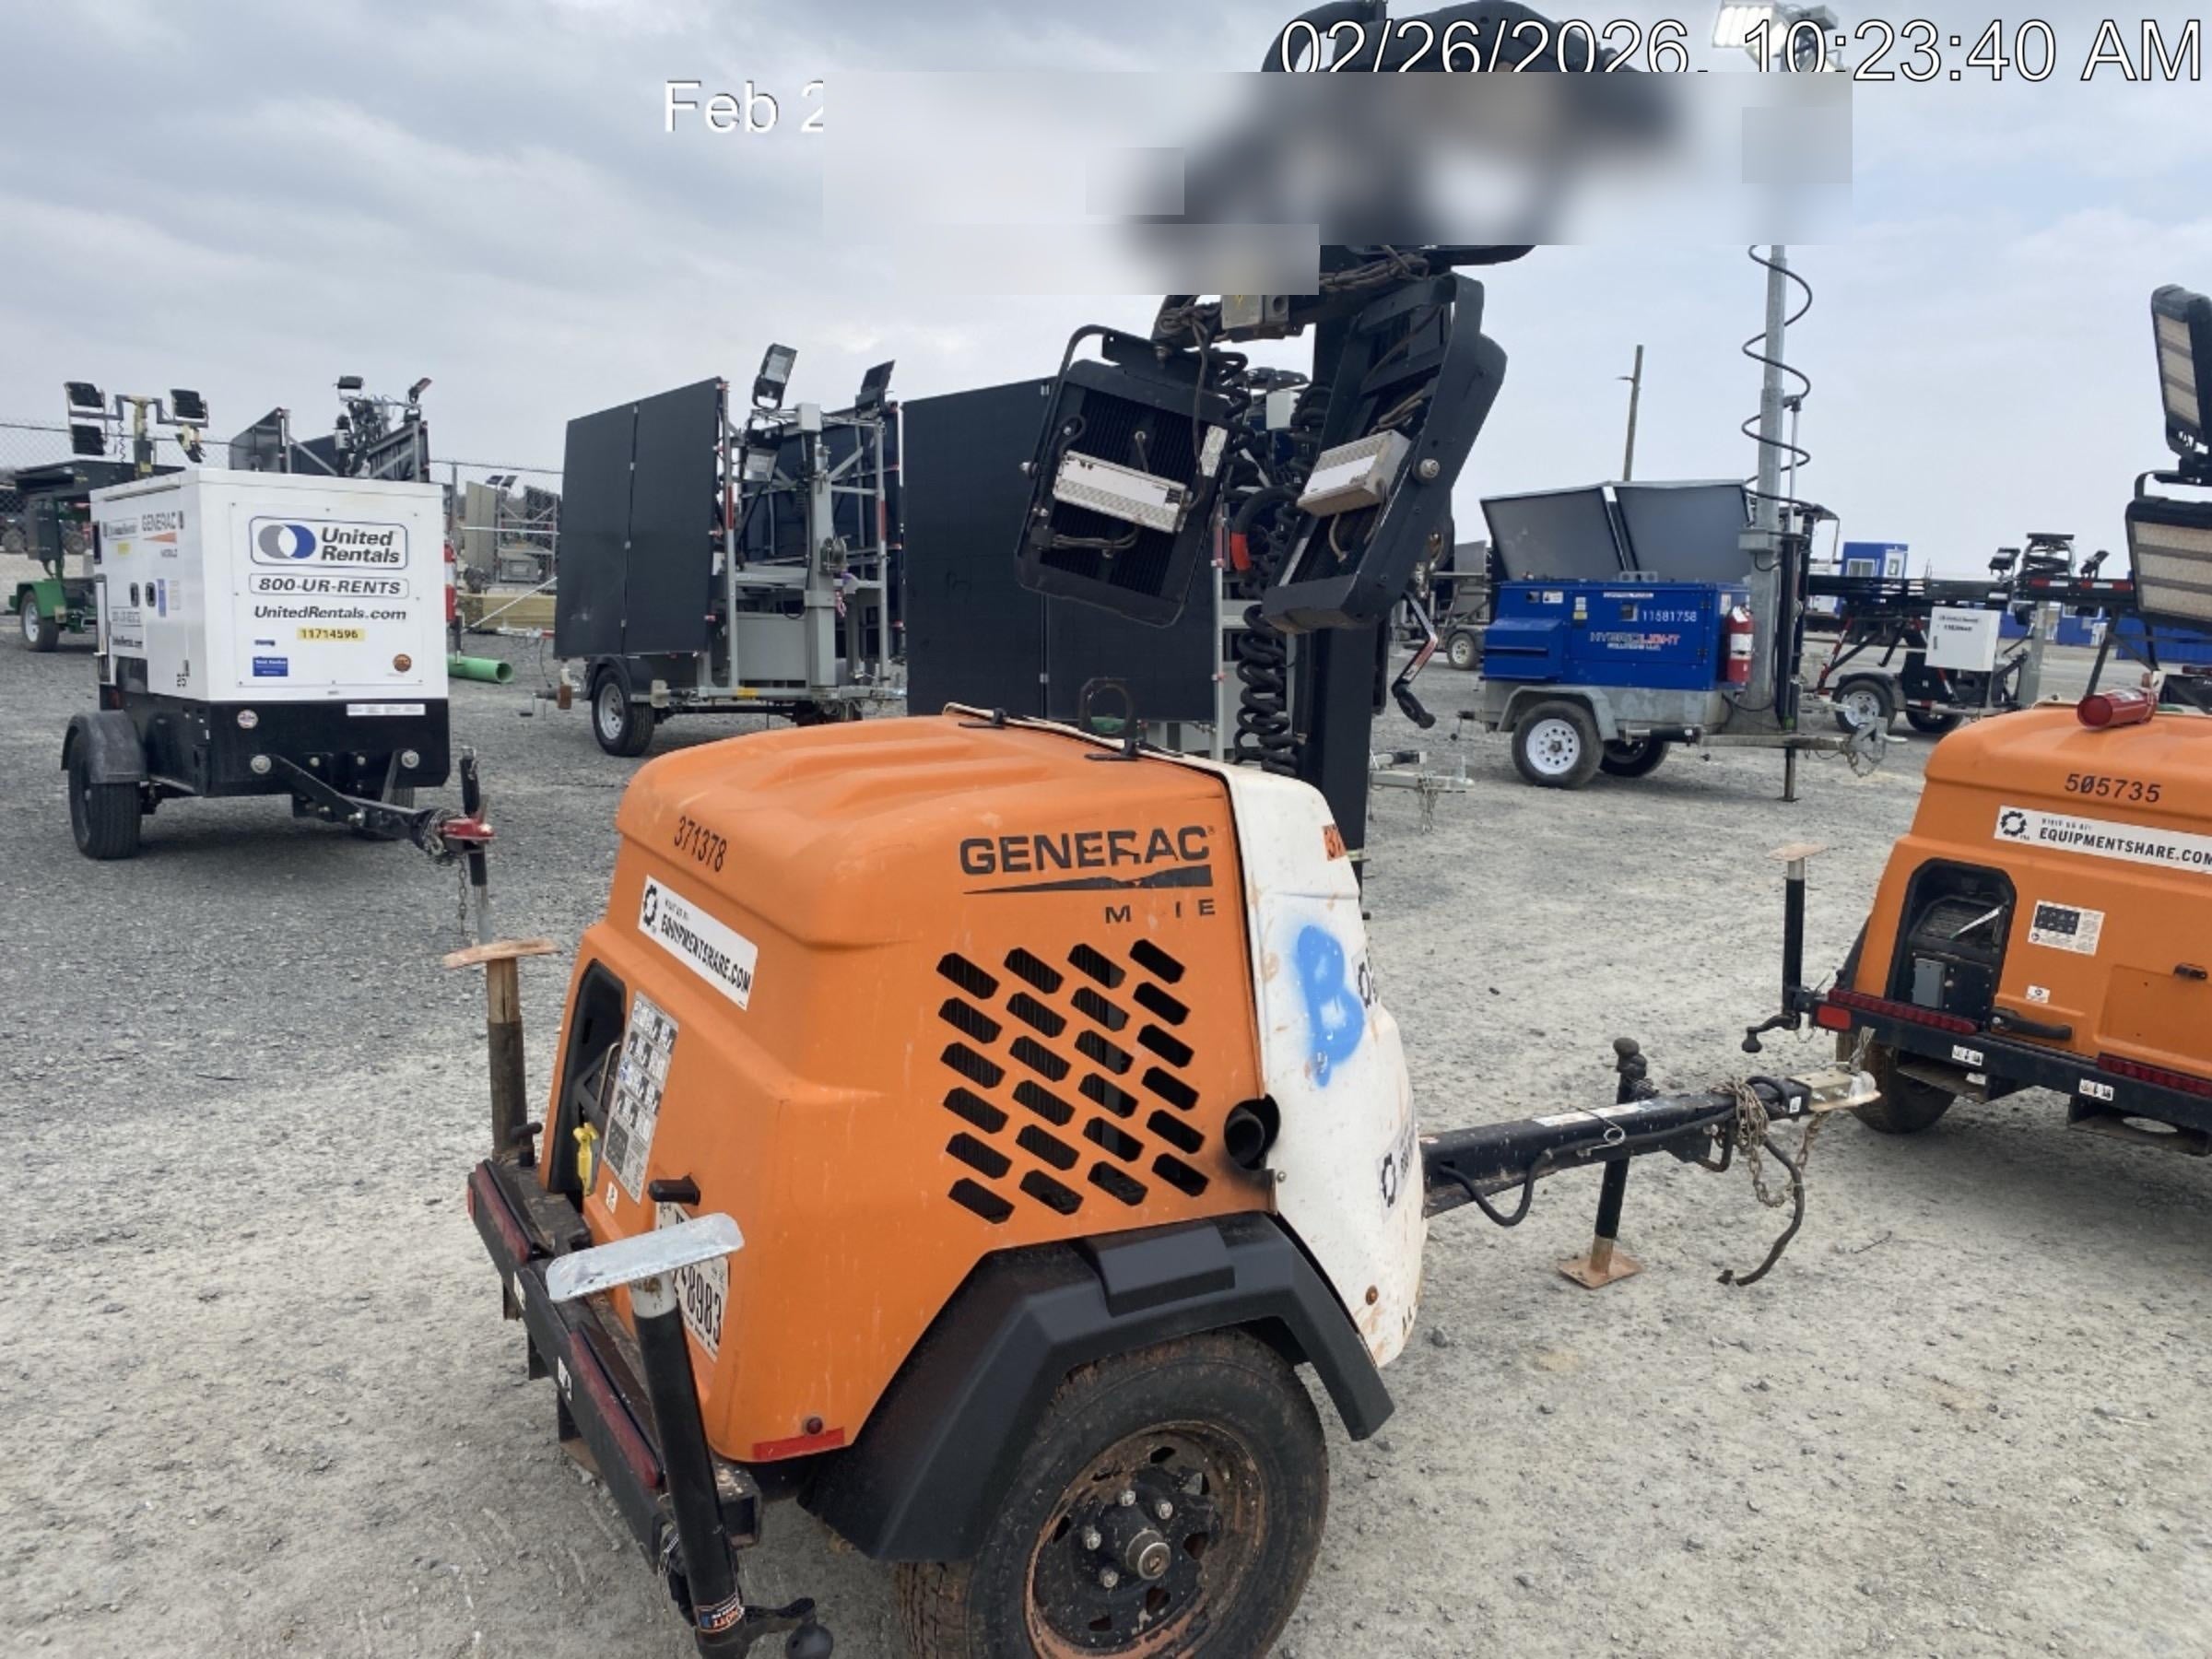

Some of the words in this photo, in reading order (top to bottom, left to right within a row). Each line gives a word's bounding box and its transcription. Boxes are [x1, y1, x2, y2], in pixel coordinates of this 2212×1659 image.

[322, 527, 394, 547] United
[321, 545, 400, 563] Rentals
[259, 578, 401, 594] 800-UR-RENTS
[254, 606, 406, 620] UnitedRentals.com
[300, 629, 359, 639] 11714596
[2065, 773, 2161, 803] 505735
[674, 815, 727, 873] 371378
[959, 826, 1210, 876] GENERAC
